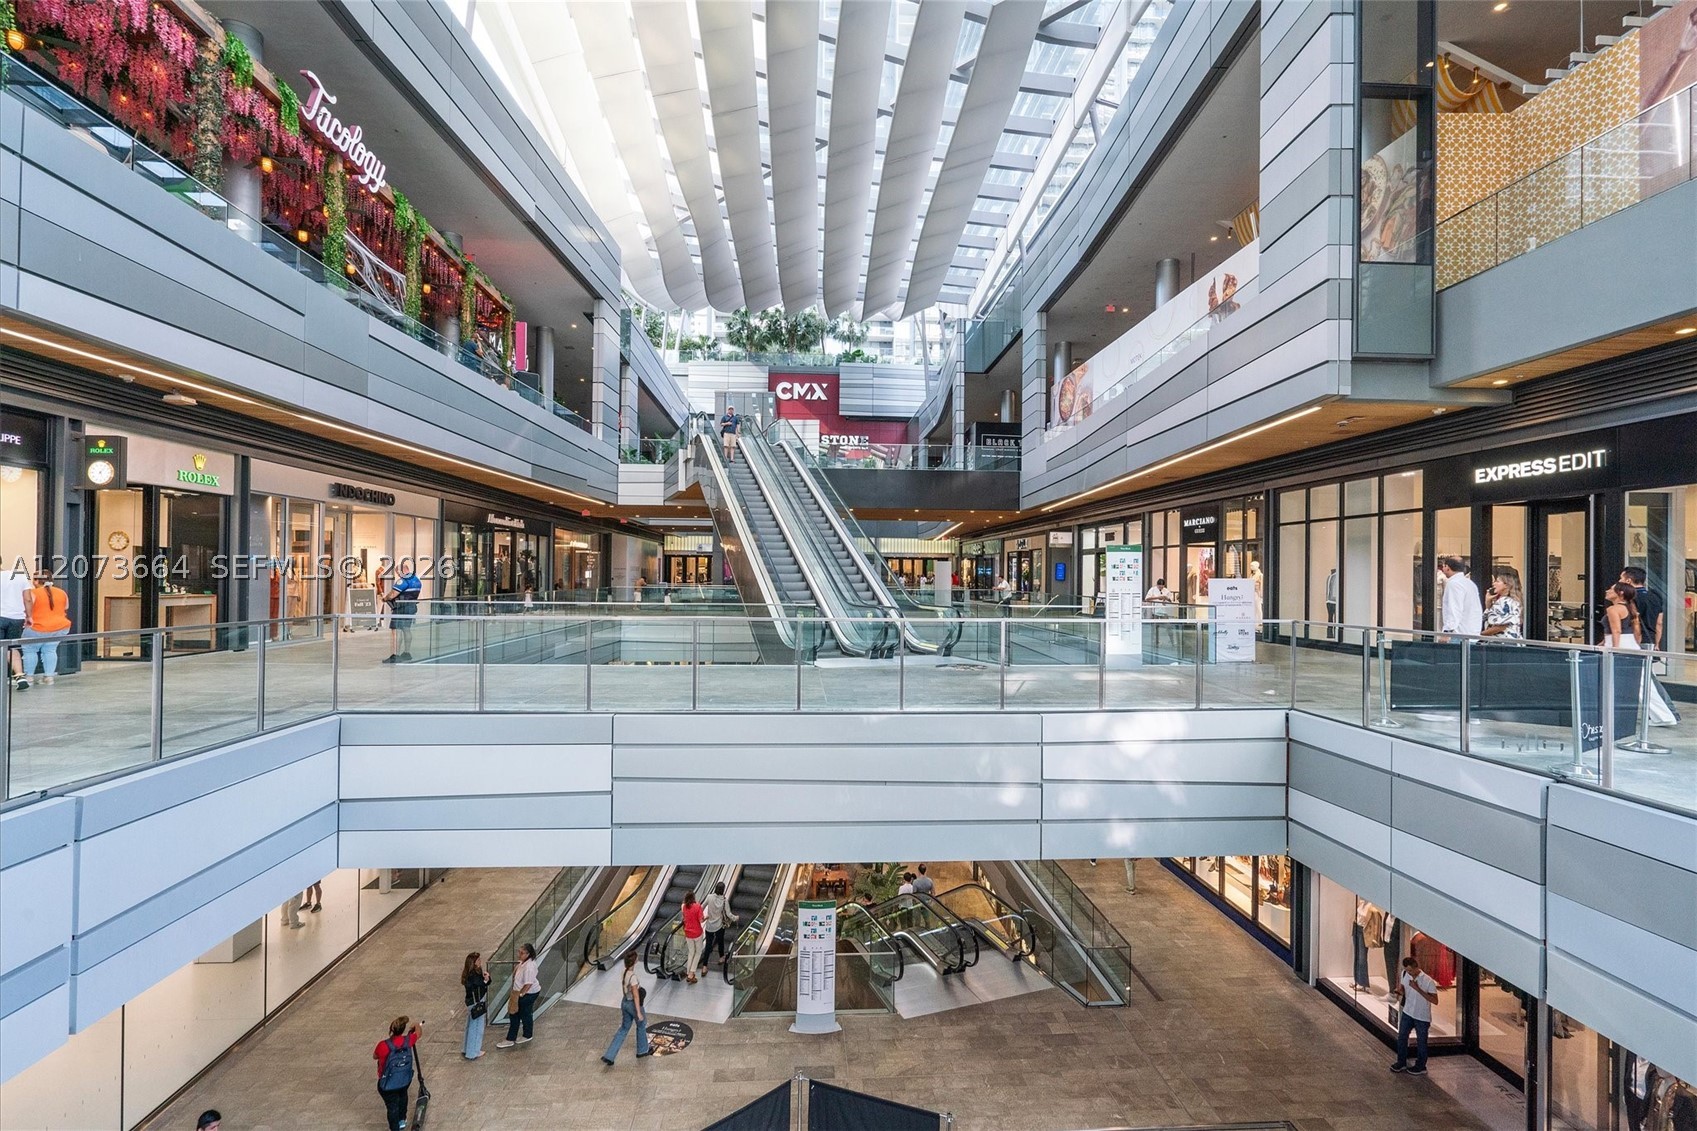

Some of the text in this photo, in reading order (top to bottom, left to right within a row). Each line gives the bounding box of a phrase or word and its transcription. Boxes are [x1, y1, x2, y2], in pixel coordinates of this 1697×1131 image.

[300, 69, 386, 193] Tacology
[775, 381, 828, 400] CMX
[0, 433, 22, 445] IPPE
[820, 434, 869, 446] STONE
[1474, 449, 1606, 483] EXPRESS EDIT
[177, 469, 221, 487] ROLEX
[334, 482, 396, 506] INDOCHINO
[1183, 516, 1215, 527] MARCIANO
